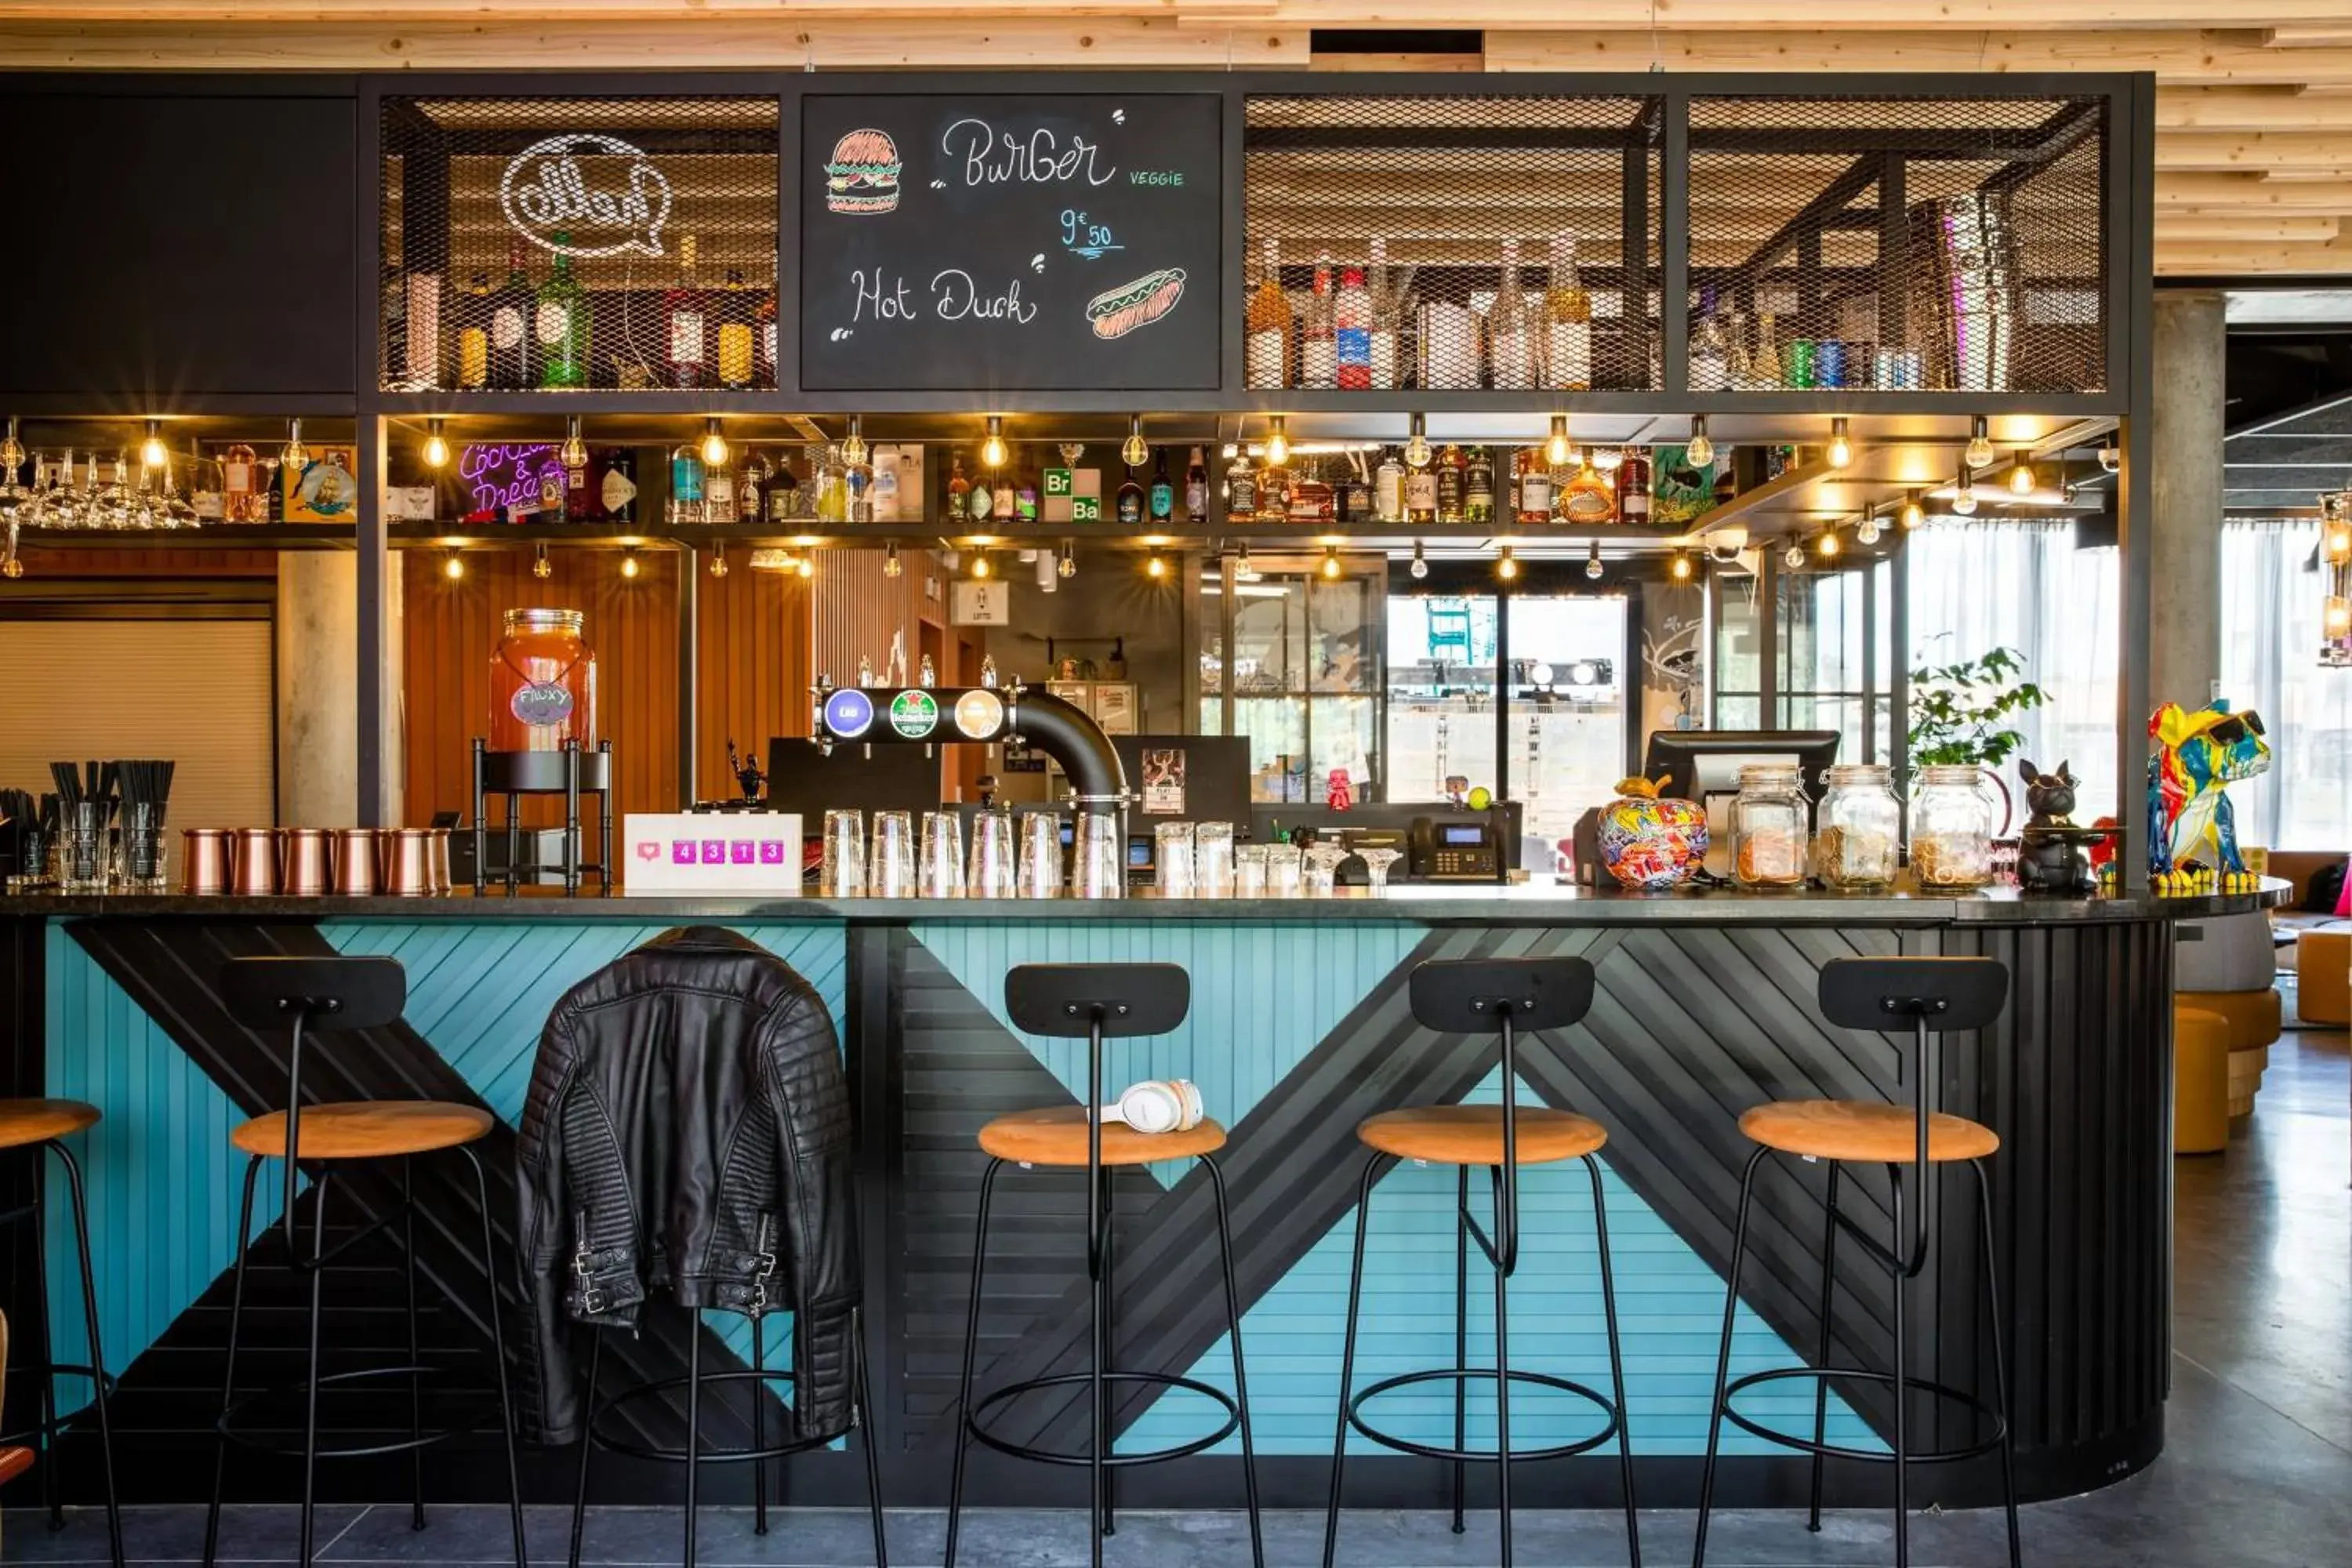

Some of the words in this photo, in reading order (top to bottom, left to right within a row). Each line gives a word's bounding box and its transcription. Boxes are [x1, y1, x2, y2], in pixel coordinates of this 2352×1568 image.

[851, 267, 916, 322] Hot
[931, 269, 1037, 324] Duck
[1047, 474, 1070, 492] Br
[1073, 502, 1098, 519] Ba
